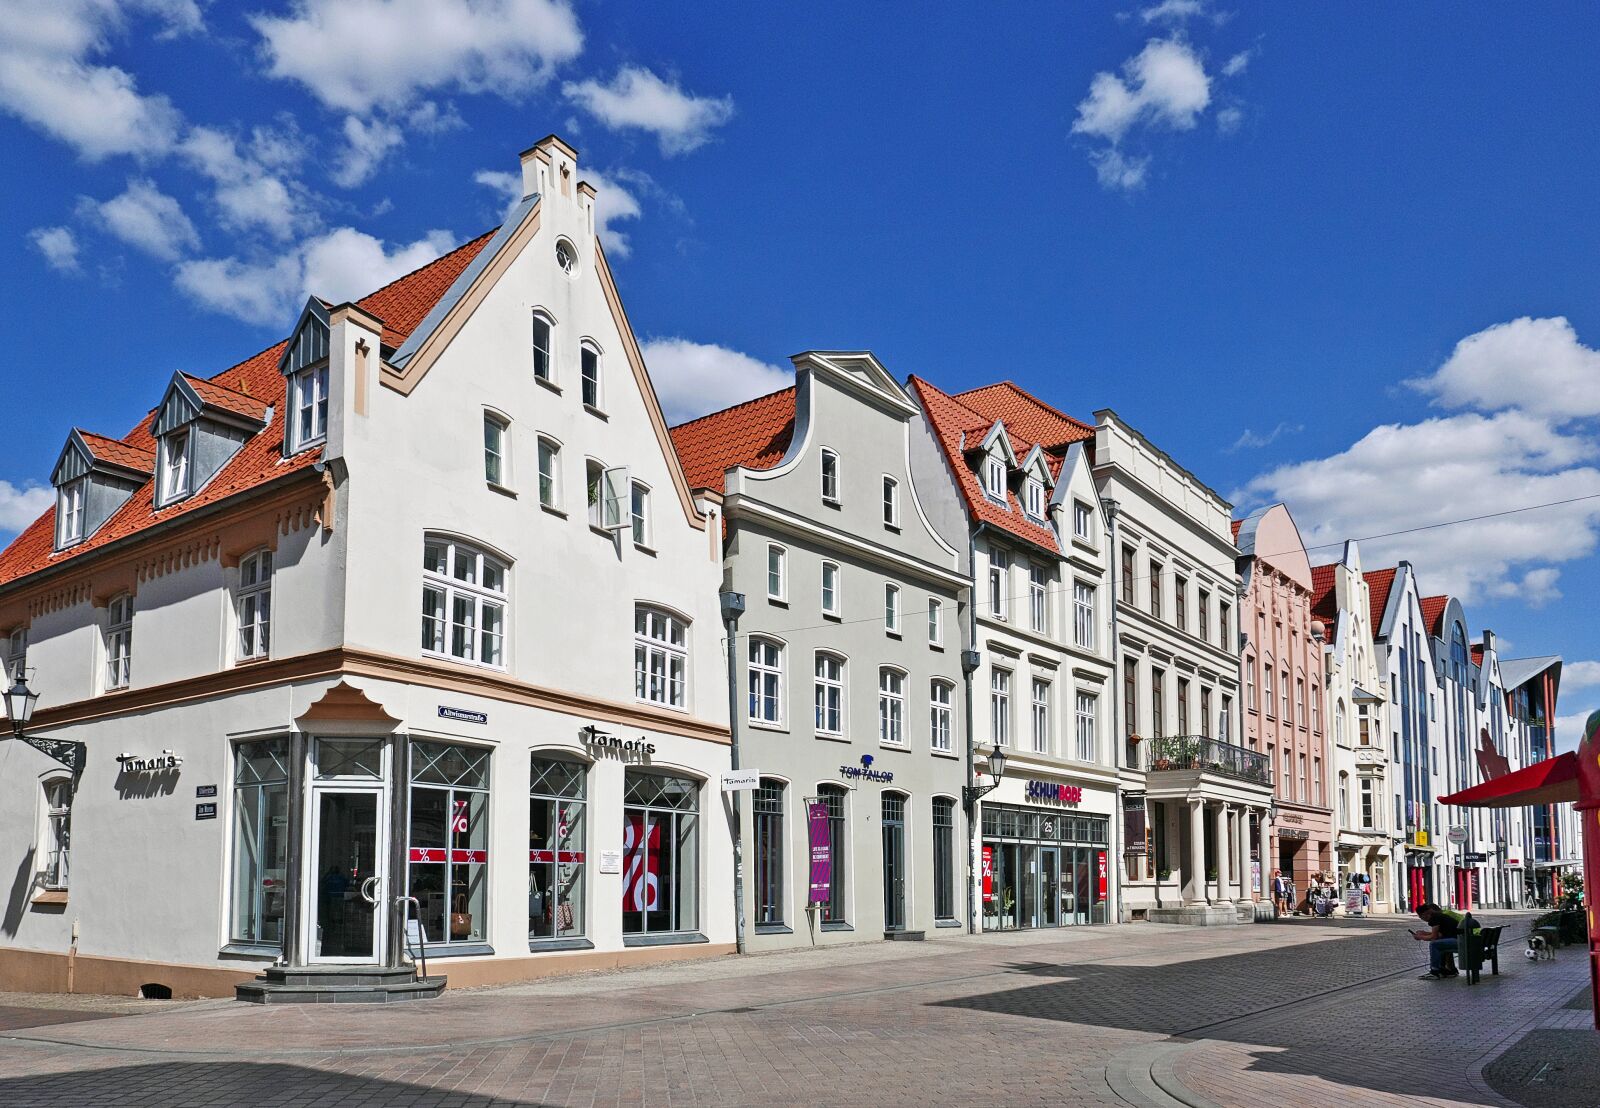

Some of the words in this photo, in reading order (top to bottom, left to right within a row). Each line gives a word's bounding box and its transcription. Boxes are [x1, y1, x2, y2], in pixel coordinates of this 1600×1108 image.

[840, 765, 861, 779] TOM
[861, 768, 894, 783] TAILOR
[1044, 821, 1053, 833] 25
